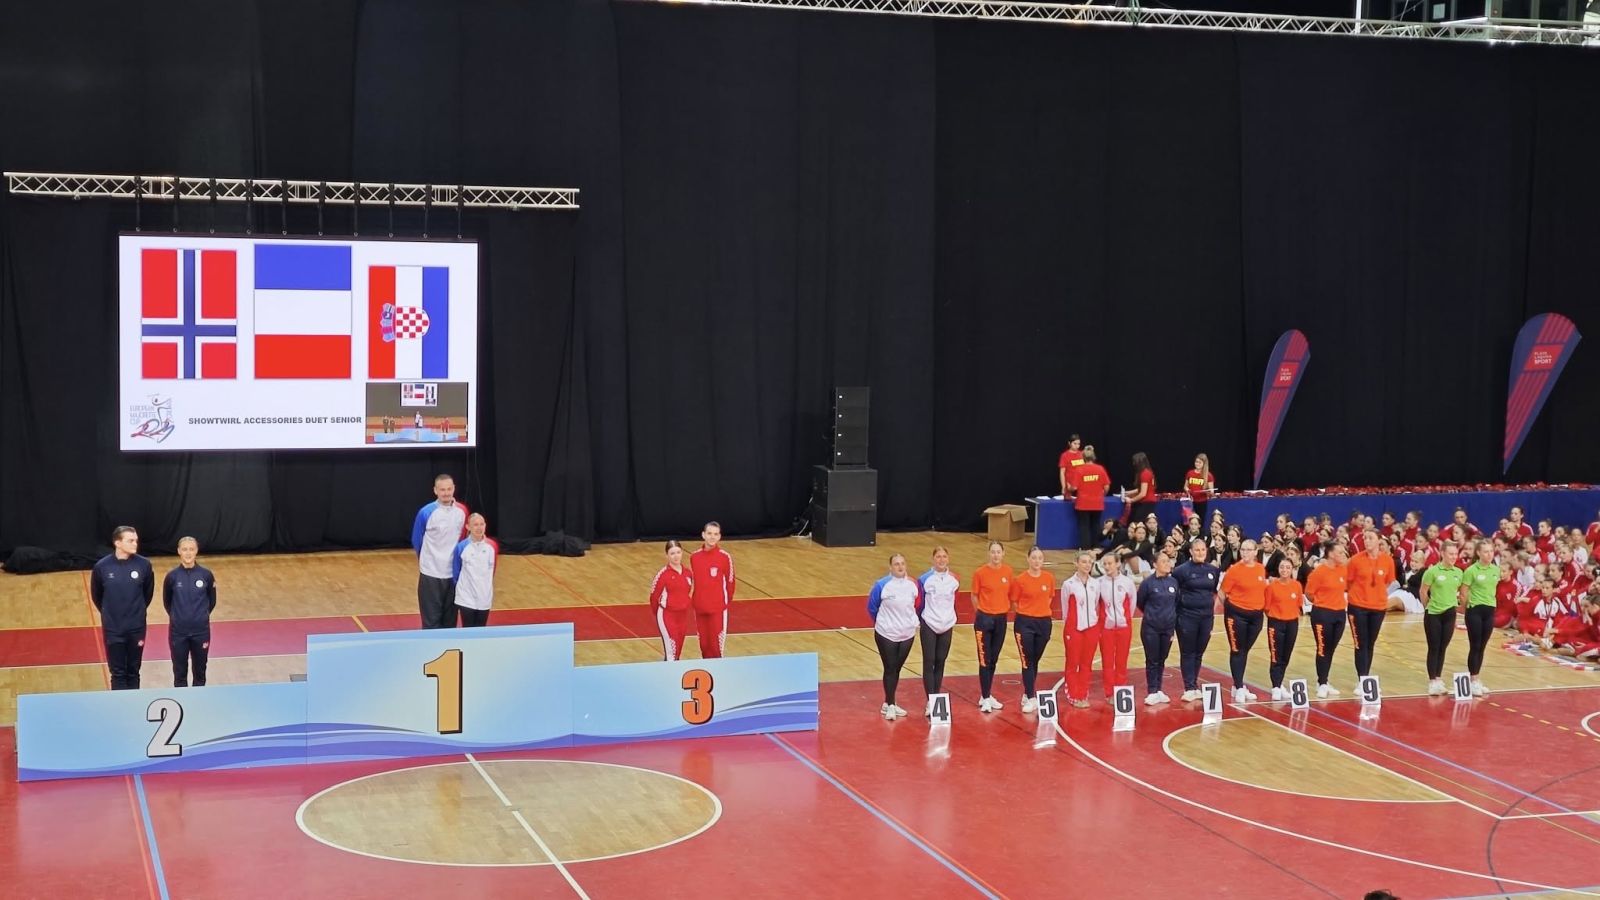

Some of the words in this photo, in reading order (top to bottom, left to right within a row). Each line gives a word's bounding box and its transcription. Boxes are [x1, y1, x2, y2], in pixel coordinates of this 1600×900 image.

[188, 417, 242, 425] SHOWTWIRL
[243, 416, 303, 424] ACCESSORIES
[305, 416, 328, 424] DUET
[330, 416, 362, 424] SENIOR
[1083, 474, 1099, 482] STAFF
[424, 648, 463, 735] 1
[682, 669, 714, 725] 3
[1205, 686, 1218, 711] 7
[1292, 681, 1307, 706] 8
[1362, 678, 1379, 702] 9
[1454, 675, 1471, 697] 10
[932, 696, 949, 721] 4
[1038, 693, 1056, 718] 5
[1116, 688, 1133, 713] 6
[146, 698, 184, 758] 2
